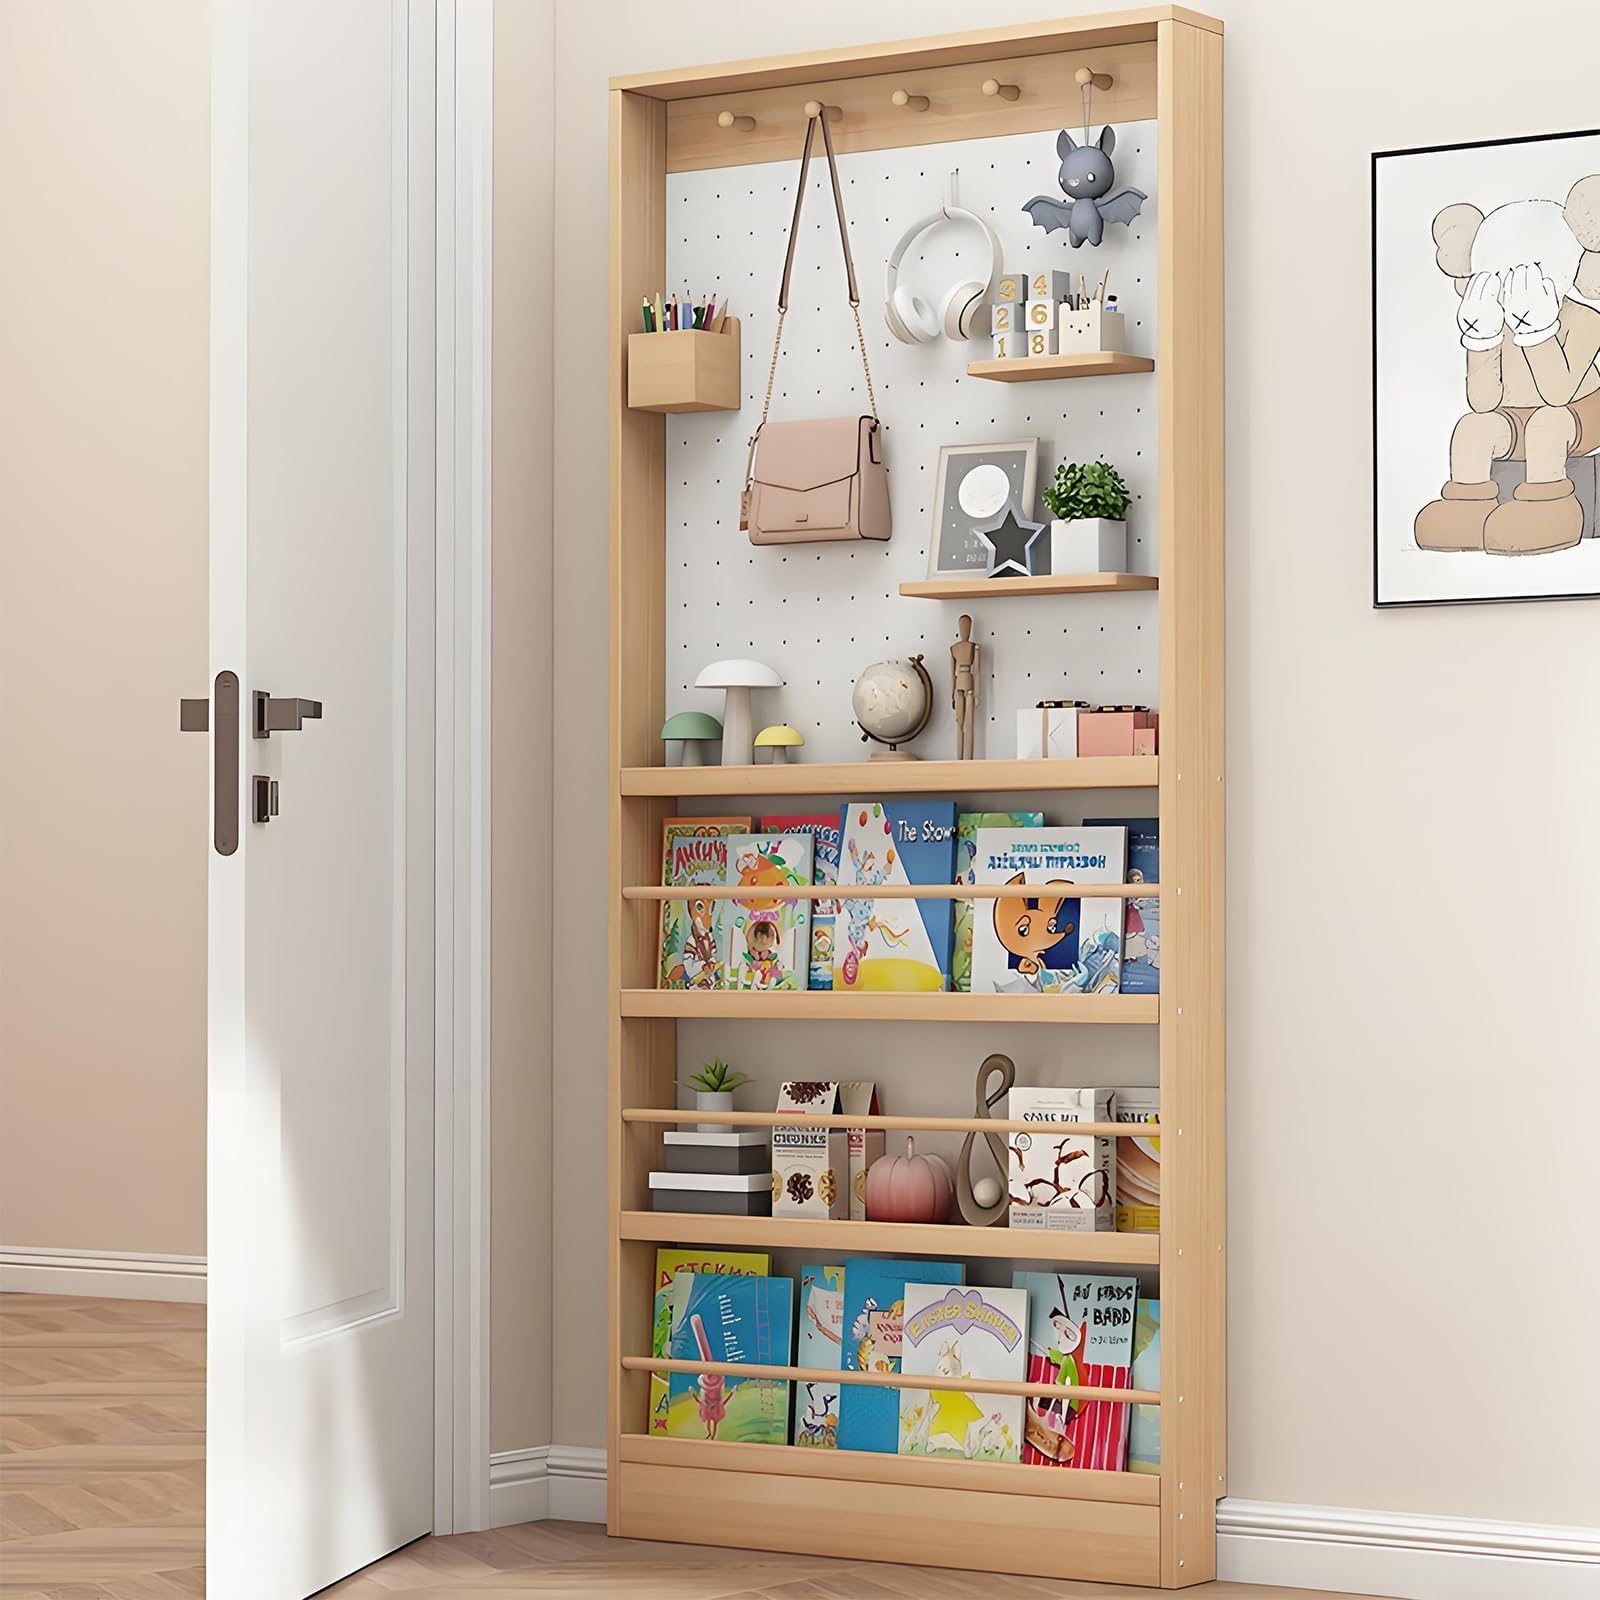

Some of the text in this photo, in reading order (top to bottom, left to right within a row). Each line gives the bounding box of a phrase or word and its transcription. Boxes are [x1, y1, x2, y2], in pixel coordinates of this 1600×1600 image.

[1032, 274, 1047, 296] 4
[996, 307, 1009, 329] 2
[1031, 303, 1048, 325] 6
[998, 337, 1006, 358] 1
[1031, 334, 1044, 354] 8
[898, 820, 917, 842] The
